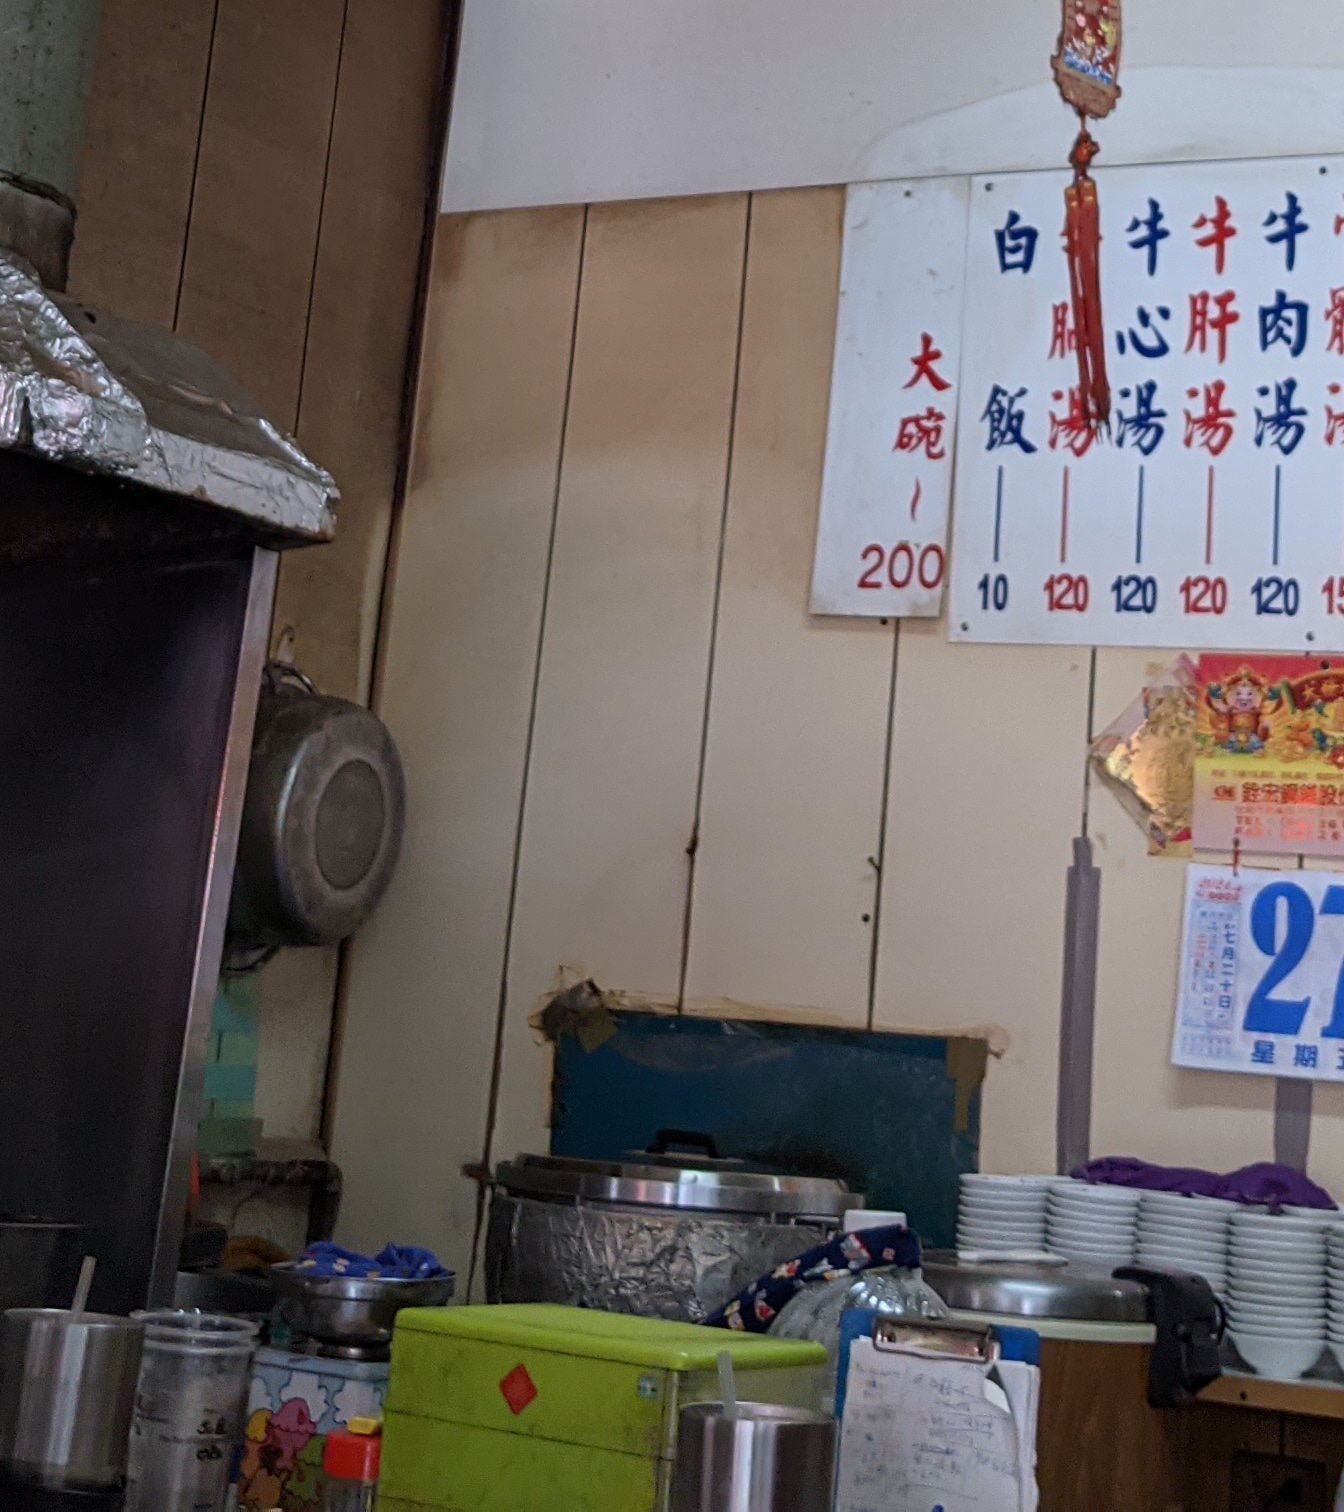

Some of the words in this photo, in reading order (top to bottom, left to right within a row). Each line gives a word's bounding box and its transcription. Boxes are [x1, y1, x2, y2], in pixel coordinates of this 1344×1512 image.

[1115, 197, 1171, 457] 牛心湯
[1183, 194, 1240, 457] 牛肝湯
[1252, 190, 1310, 456] 牛肉湯
[857, 542, 945, 590] 200
[977, 572, 1009, 612] 10
[1043, 573, 1089, 613] 120
[1110, 573, 1157, 613] 120
[1179, 575, 1228, 616] 120
[1250, 575, 1300, 616] 120
